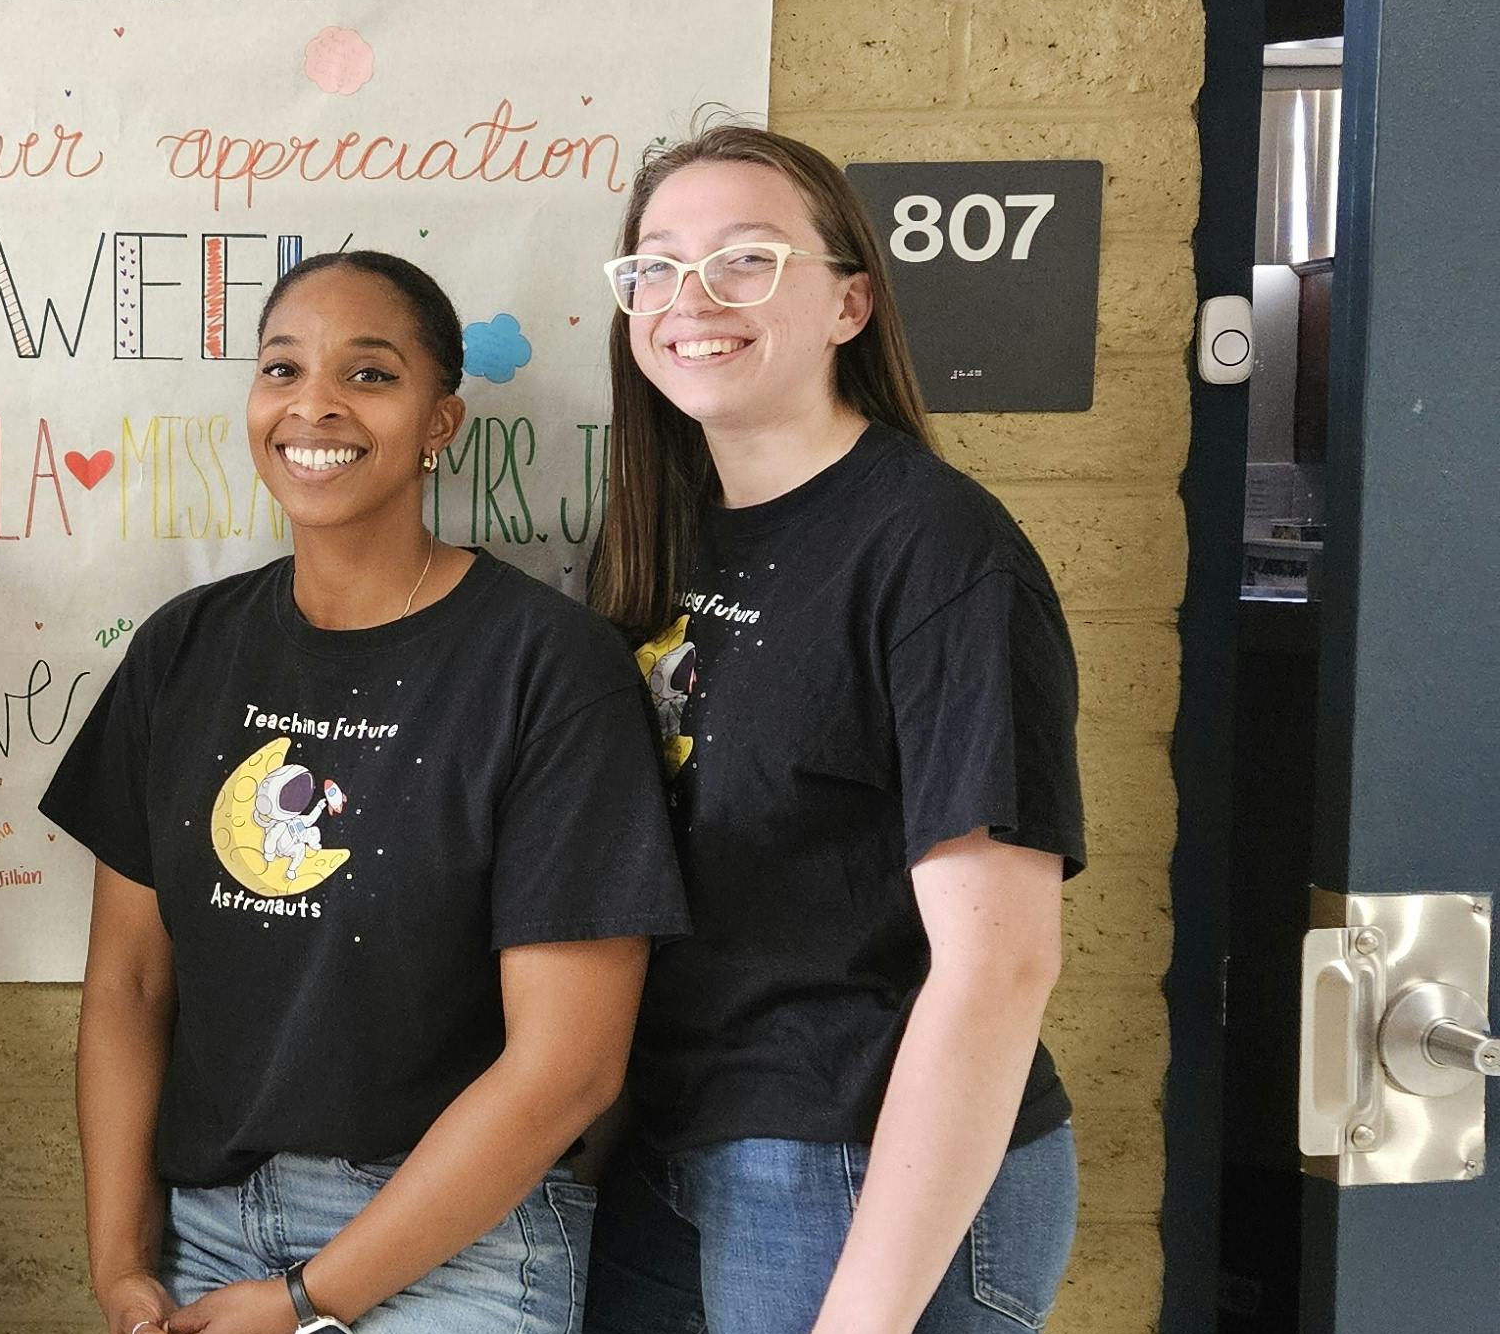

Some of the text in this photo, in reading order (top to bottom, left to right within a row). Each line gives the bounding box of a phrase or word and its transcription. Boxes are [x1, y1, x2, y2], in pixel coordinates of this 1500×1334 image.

[156, 98, 626, 212] appreciation
[889, 193, 1056, 263] 807
[702, 593, 761, 624] Future
[243, 703, 399, 741] Teaching Future
[210, 882, 322, 918] Astronauts
